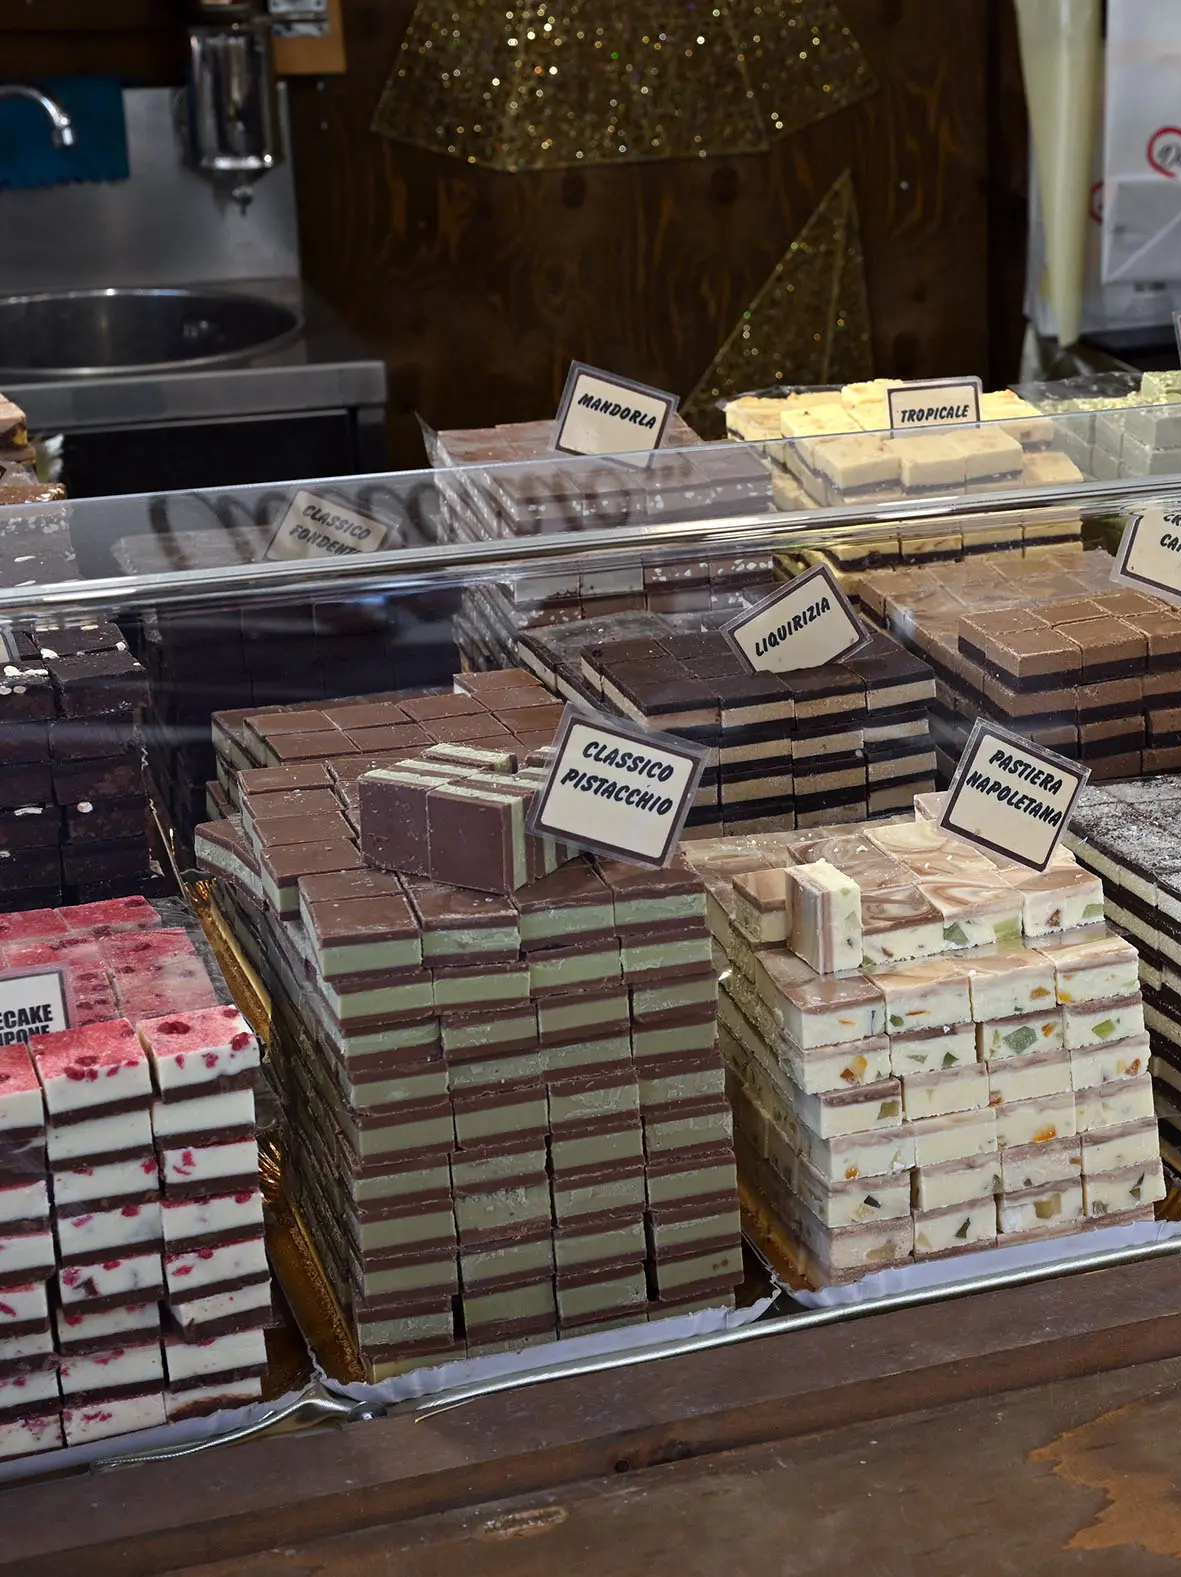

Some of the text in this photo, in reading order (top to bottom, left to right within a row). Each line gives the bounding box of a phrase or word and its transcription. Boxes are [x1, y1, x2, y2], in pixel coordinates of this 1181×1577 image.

[577, 393, 657, 430] MANDORLA
[901, 404, 970, 424] TROPICALE
[289, 524, 363, 555] FONDENT
[302, 504, 373, 540] CLASSICO
[754, 596, 831, 657] LIQUIRIZIA
[582, 740, 675, 783] CLASSICO
[988, 749, 1064, 796] PASTIERA
[560, 767, 674, 816] PISTACCHIO
[965, 770, 1064, 828] NAPOLETANA
